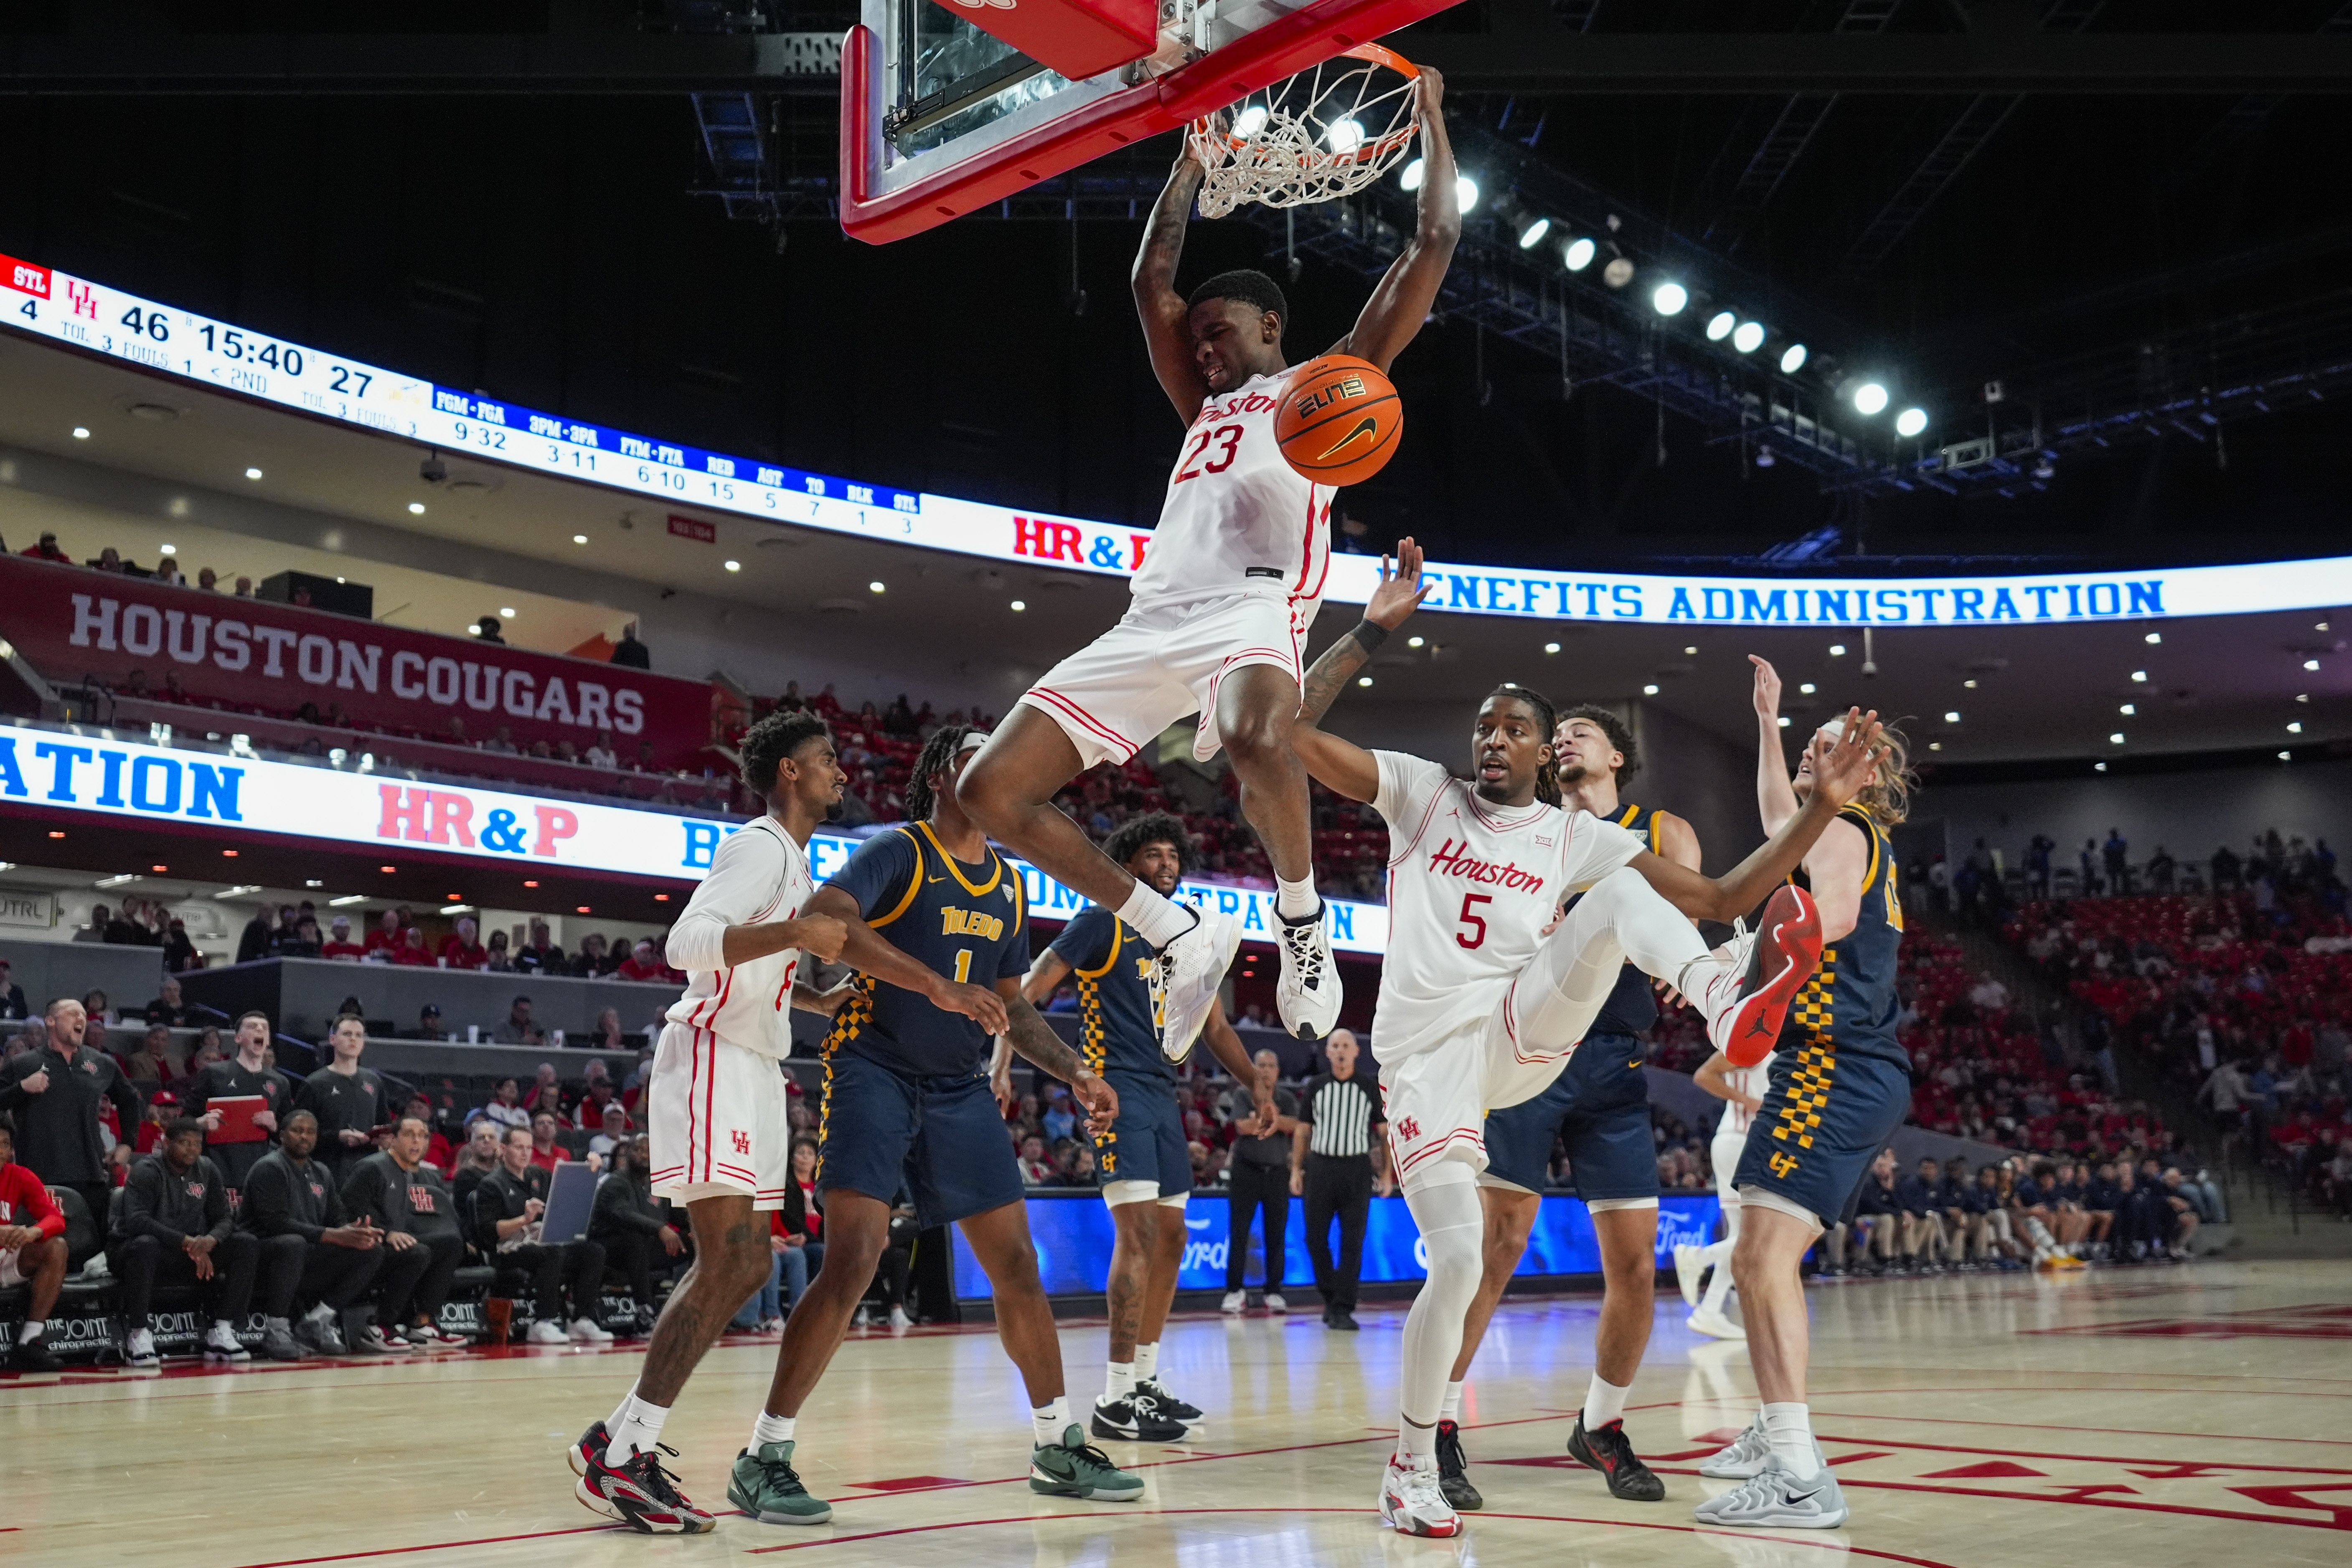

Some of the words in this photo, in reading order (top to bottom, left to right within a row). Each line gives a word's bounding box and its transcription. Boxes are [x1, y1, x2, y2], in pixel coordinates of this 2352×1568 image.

[13, 266, 47, 293] STL
[20, 300, 38, 320] 4
[121, 306, 170, 342] 46
[102, 335, 112, 349] 3
[183, 359, 191, 372] 1
[200, 324, 303, 376] 15:40
[329, 366, 373, 398] 27
[1295, 377, 1366, 419] ELITE
[338, 402, 346, 417] 3
[409, 421, 417, 435] 3
[1174, 424, 1245, 484] 23
[709, 481, 734, 501] 15
[765, 493, 776, 509] 5
[809, 501, 820, 516] 7
[859, 510, 865, 525] 1
[902, 518, 911, 534] 3
[757, 468, 784, 488] AST
[806, 476, 825, 496] TO
[847, 485, 874, 504] BLK
[893, 494, 918, 513] STL
[1377, 567, 1643, 618] ENEFITS
[1668, 580, 2165, 622] ADMINISTRATION
[69, 592, 382, 694] HOUSTON
[391, 651, 645, 734] COUGARS
[377, 783, 579, 857] HR&P
[1429, 837, 1544, 895] Houston
[1456, 892, 1493, 949] 5
[954, 948, 973, 984] 1
[730, 1128, 751, 1156] UH
[46, 1318, 64, 1332] THE
[64, 1317, 107, 1340] JOINT
[153, 1312, 195, 1333] JOINT
[440, 1303, 475, 1321] JOINT
[48, 1337, 112, 1351] chiropractic
